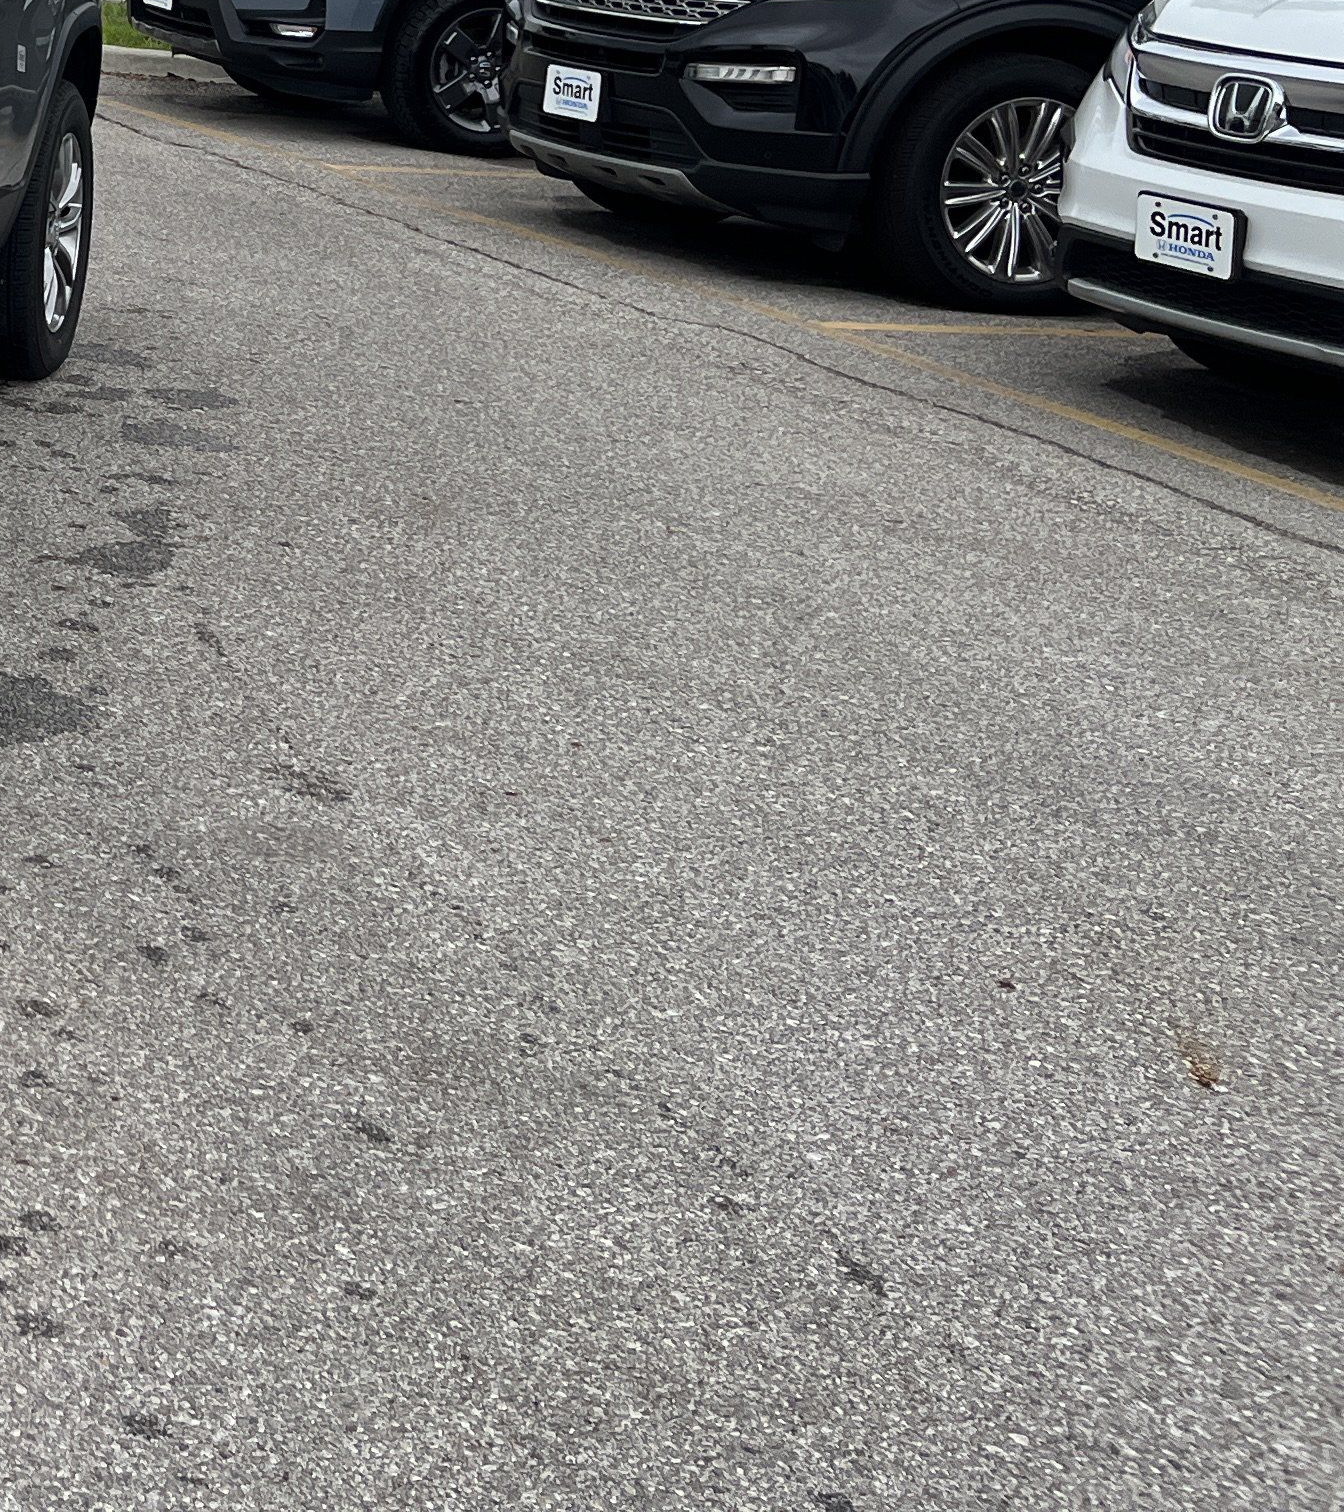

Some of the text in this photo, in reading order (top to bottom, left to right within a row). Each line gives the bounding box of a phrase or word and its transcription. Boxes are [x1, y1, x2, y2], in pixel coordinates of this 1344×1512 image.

[553, 76, 593, 102] Smart
[1149, 211, 1223, 252] Smart
[1167, 243, 1215, 262] HONDA
